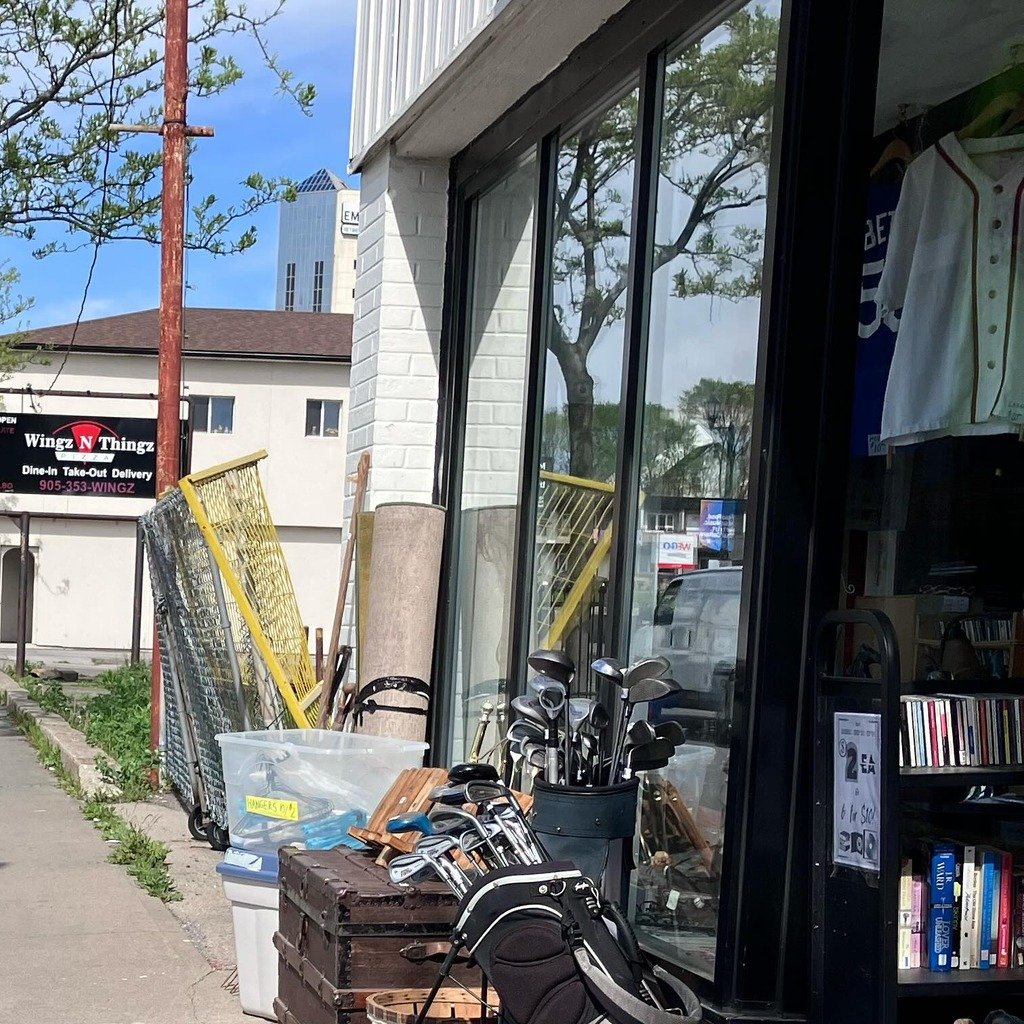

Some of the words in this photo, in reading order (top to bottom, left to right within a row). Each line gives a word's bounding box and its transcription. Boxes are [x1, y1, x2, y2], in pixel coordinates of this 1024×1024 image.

[24, 433, 74, 451] Wingz
[79, 435, 93, 449] N
[97, 436, 155, 455] Thingz
[59, 452, 110, 461] PIZZA
[22, 465, 57, 475] Dine-In
[62, 466, 107, 478] Take-Out
[111, 468, 153, 481] Delivery
[39, 479, 136, 494] 905-353-WINGZ
[936, 861, 945, 890] WARD
[942, 920, 951, 949] LOVER
